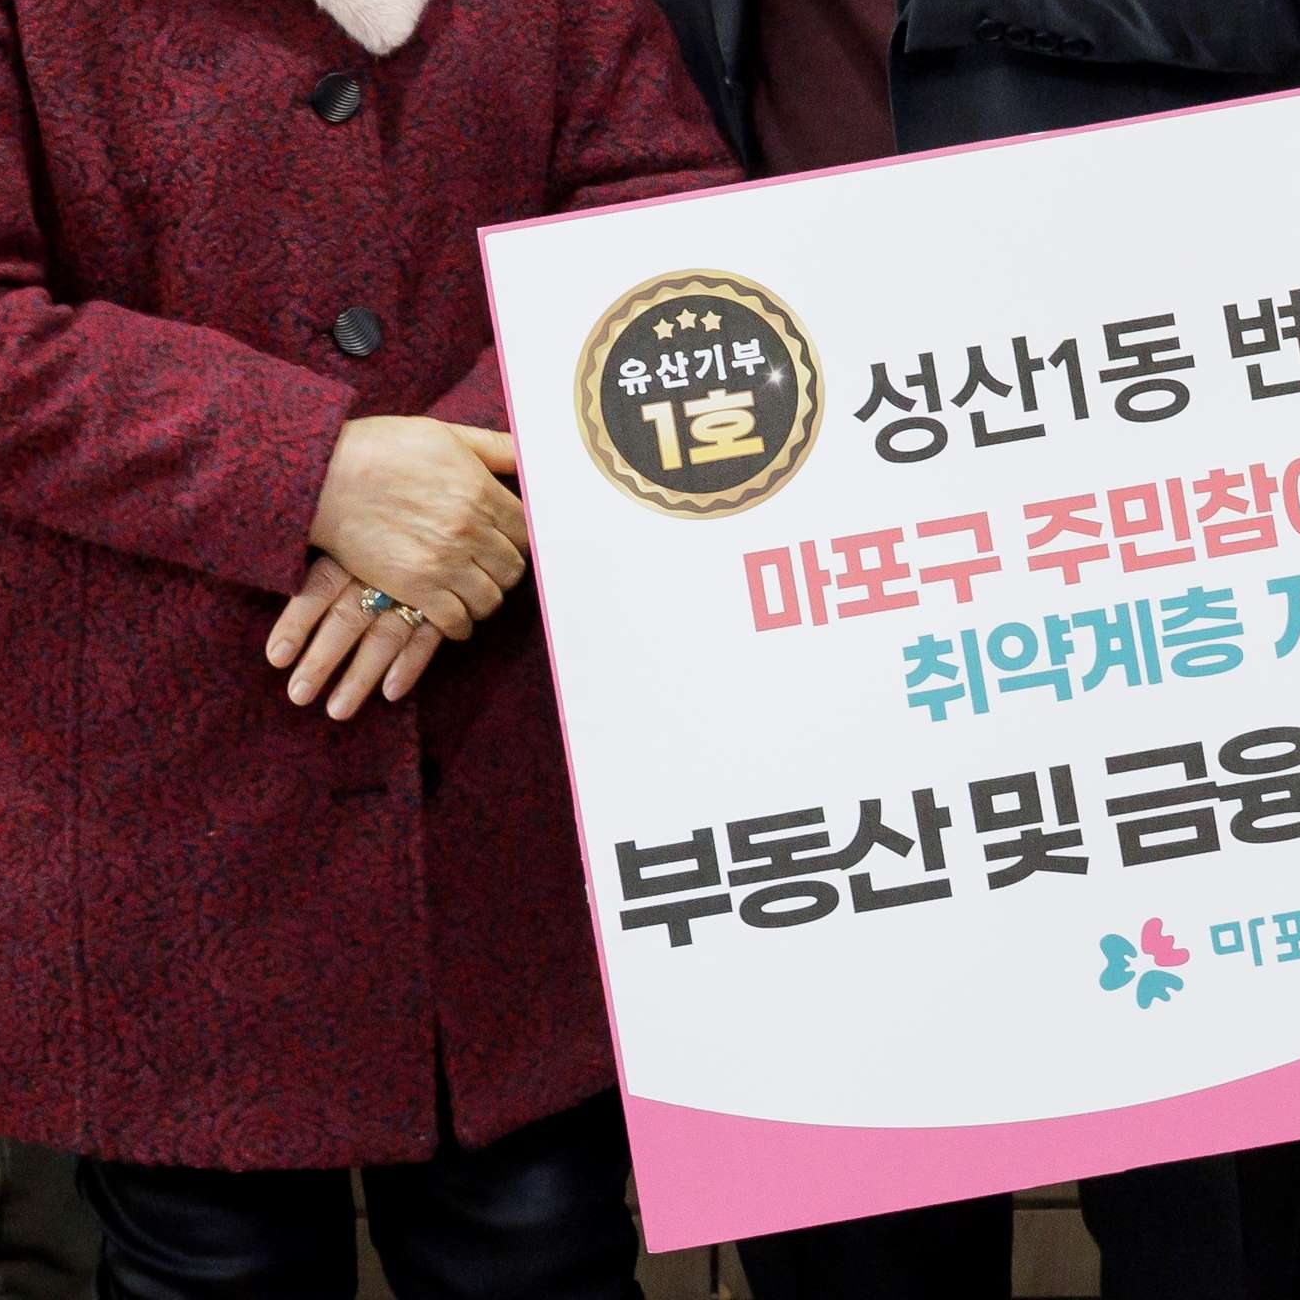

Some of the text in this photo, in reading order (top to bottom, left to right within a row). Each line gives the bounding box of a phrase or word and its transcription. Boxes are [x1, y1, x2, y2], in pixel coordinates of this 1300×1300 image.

[618, 338, 766, 396] 유산기부
[641, 388, 765, 471] 1호
[853, 312, 1195, 464] 성산1동
[743, 511, 1002, 633] 마포구
[902, 585, 1245, 723] 취약계층
[614, 787, 953, 948] 부동산
[968, 764, 1090, 891] 및
